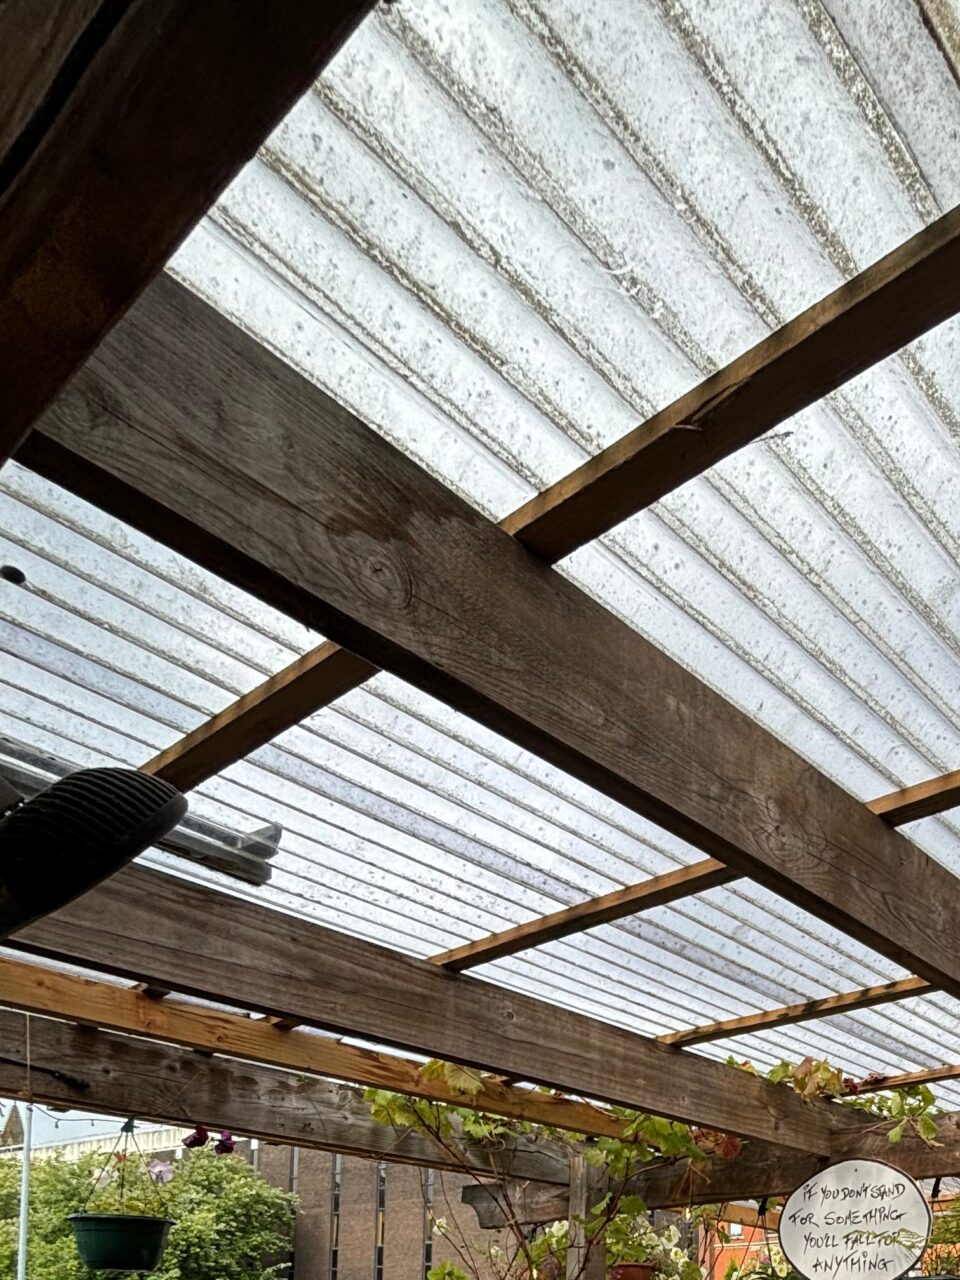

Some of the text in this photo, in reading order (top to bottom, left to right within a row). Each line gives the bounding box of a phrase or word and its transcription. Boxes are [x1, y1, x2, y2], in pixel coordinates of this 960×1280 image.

[821, 1185, 840, 1206] YOU
[840, 1183, 869, 1201] DON'T
[870, 1182, 906, 1200] STAND
[788, 1204, 907, 1228] FOR SOMETHING
[804, 1232, 839, 1255] YOU'LL
[843, 1230, 875, 1250] FALL
[813, 1250, 894, 1280] ANYTHING
